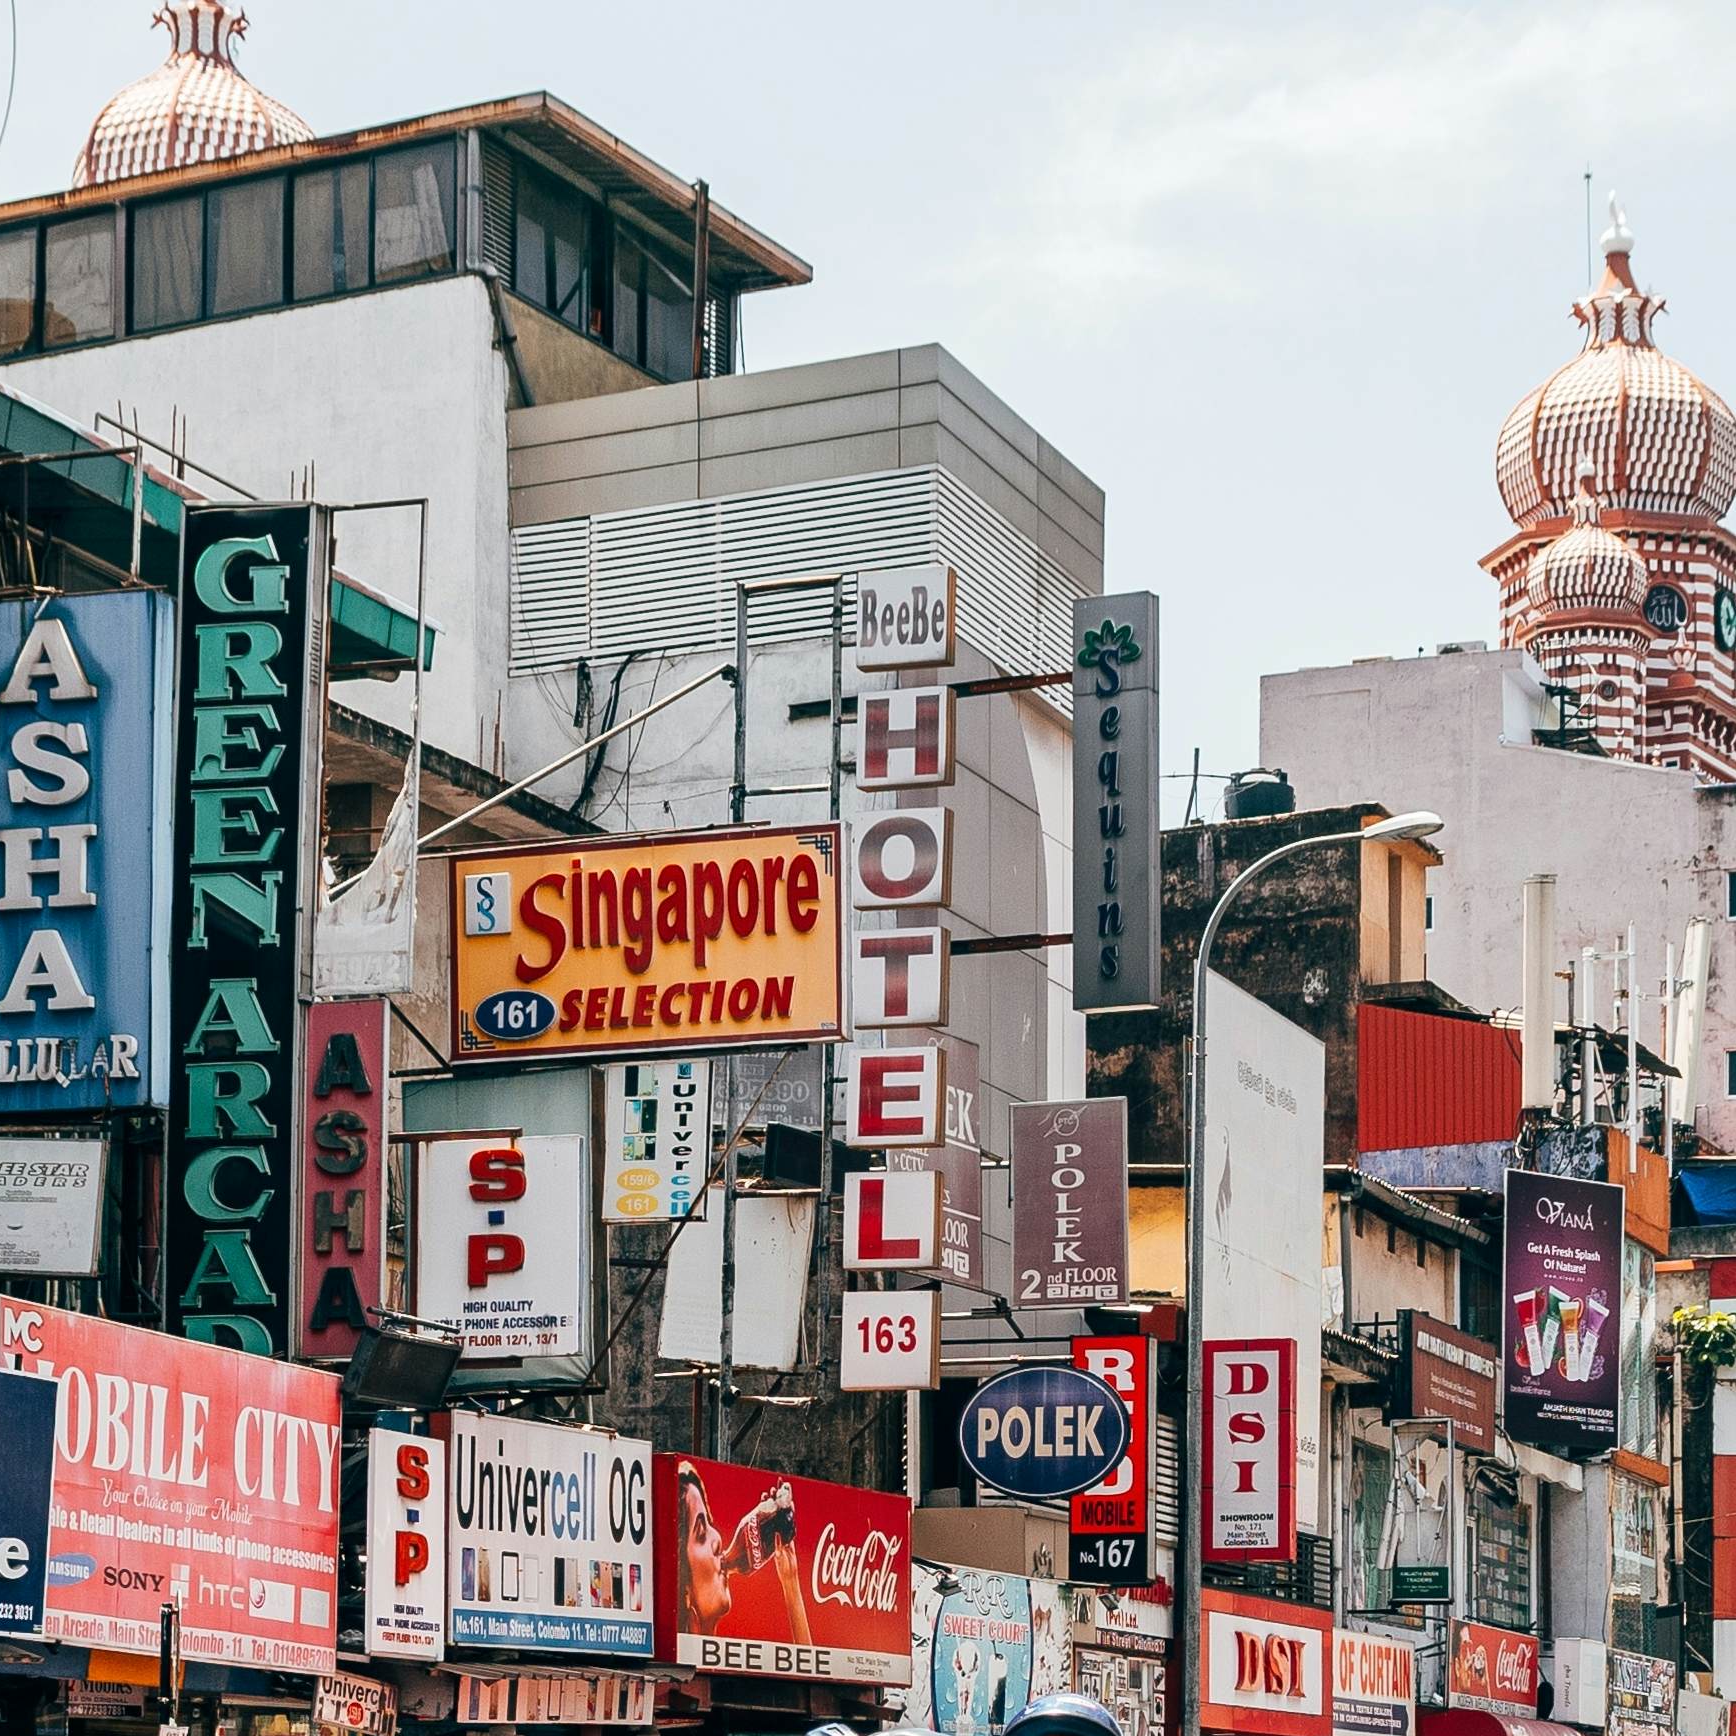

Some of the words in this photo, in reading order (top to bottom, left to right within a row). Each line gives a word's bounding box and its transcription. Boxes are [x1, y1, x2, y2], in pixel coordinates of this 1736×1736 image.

[861, 585, 947, 649] BeeBe
[190, 533, 291, 949] GREEN
[1096, 648, 1125, 979] Sequins
[515, 854, 821, 983] Singapore
[855, 694, 941, 1260] HOTEL
[493, 1000, 538, 1029] 161
[558, 975, 795, 1031] SELECTION
[28, 1162, 89, 1177] STAR
[179, 977, 277, 1359] ARCAD
[310, 1033, 372, 1330] ASHA
[1051, 1143, 1085, 1263] POLEK
[1527, 1242, 1543, 1254] Get
[1551, 1245, 1574, 1259] Fresh
[1575, 1248, 1601, 1262] Splash
[463, 1301, 487, 1313] HIGH
[490, 1300, 533, 1313] QUALITY
[1020, 1269, 1042, 1300] 2
[1065, 1267, 1119, 1283] FLOOR
[3, 1307, 43, 1352] MC
[465, 1317, 499, 1331] PHONE
[469, 1335, 502, 1347] FLOOR
[536, 1333, 557, 1345] 13/1
[857, 1315, 917, 1353] 163
[977, 1405, 1105, 1459] POLEK
[1224, 1363, 1270, 1492] DSI
[233, 1405, 340, 1514] CITY
[101, 1478, 130, 1507] Your
[133, 1485, 169, 1513] Choice
[185, 1503, 208, 1522] your
[211, 1498, 254, 1526] Mobile
[456, 1433, 598, 1542] Univercell
[608, 1456, 647, 1545] OG
[1080, 1501, 1136, 1527] MOBILE
[1219, 1512, 1274, 1522] SHOWROOM
[1224, 1538, 1258, 1546] Colombo
[80, 1511, 114, 1535] Retail
[116, 1516, 162, 1544] Dealers
[193, 1529, 224, 1553] kinds
[237, 1538, 270, 1562] phone
[272, 1546, 335, 1575] accessories
[811, 1522, 904, 1614] Coca-Cola
[103, 1566, 165, 1592] SONY
[200, 1574, 246, 1610] htc
[62, 1613, 105, 1642] Arcade,
[109, 1619, 135, 1645] Main
[488, 1618, 508, 1637] Main
[510, 1619, 536, 1642] Street,
[537, 1621, 570, 1641] Colombo
[943, 1612, 985, 1641] SWEET
[988, 1621, 1029, 1646] COURT
[701, 1639, 763, 1670] BEE
[774, 1645, 832, 1676] BEE
[1233, 1630, 1308, 1699] DSI
[1339, 1638, 1356, 1693] OF
[1360, 1643, 1412, 1700] CURTAIN
